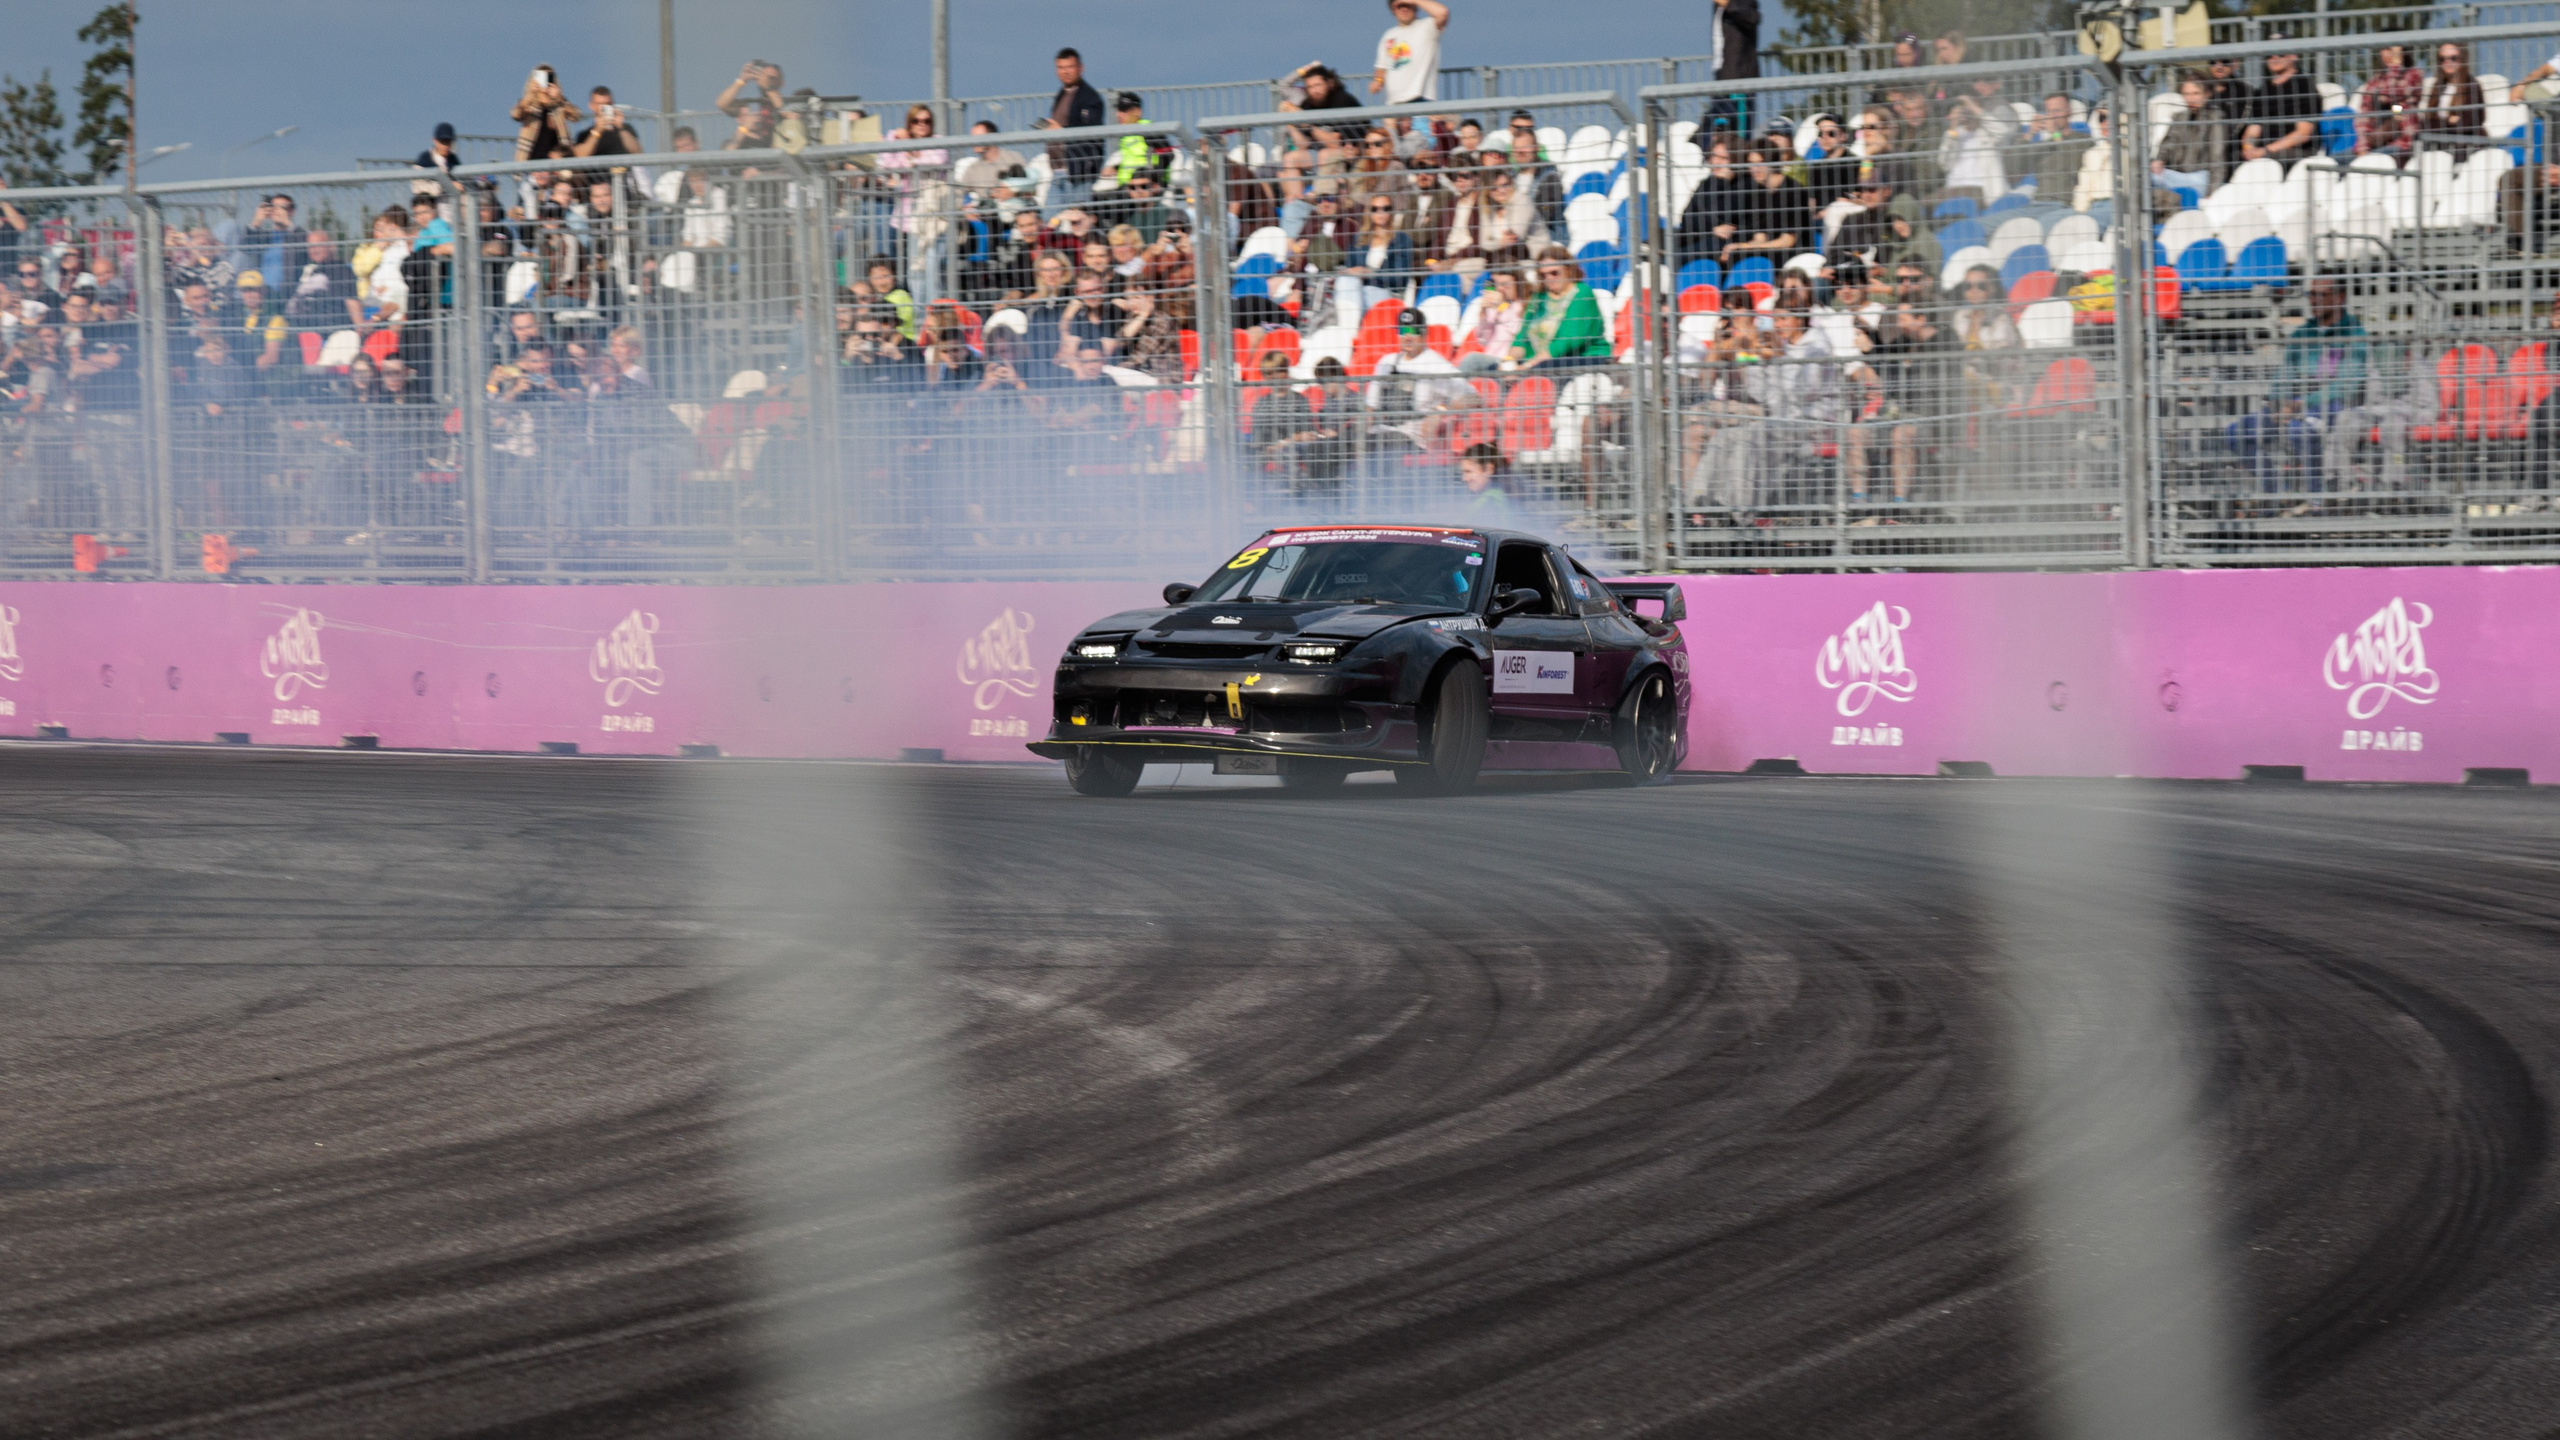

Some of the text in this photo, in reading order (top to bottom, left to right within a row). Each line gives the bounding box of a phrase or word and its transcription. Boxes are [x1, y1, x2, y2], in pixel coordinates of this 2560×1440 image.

[1227, 547, 1269, 569] 8
[1334, 573, 1368, 584] sparco
[1830, 722, 1904, 746] ДРАЙВ
[2340, 726, 2424, 751] ДРАЙВ
